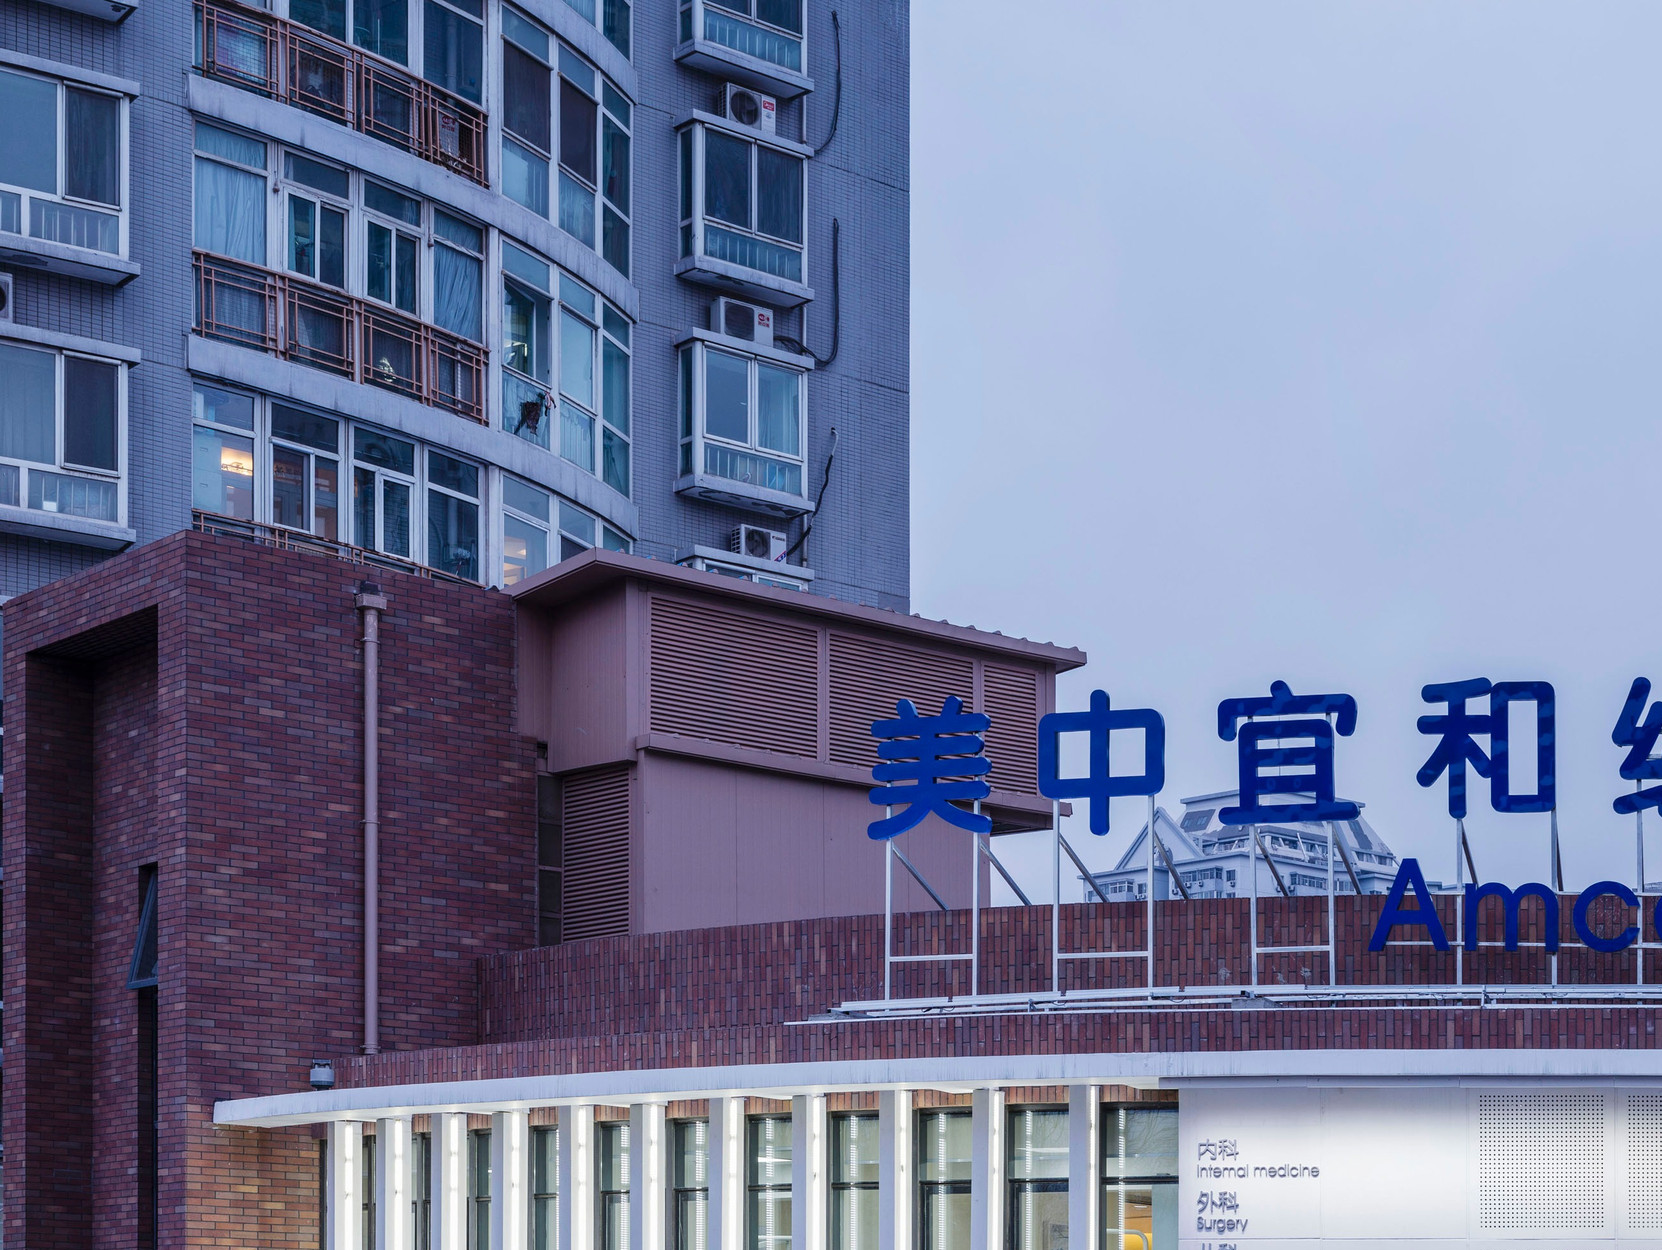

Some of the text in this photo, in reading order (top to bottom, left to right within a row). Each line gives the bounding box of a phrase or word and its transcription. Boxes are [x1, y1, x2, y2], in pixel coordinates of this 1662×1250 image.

[1197, 1138, 1240, 1161] 内科
[1196, 1164, 1320, 1179] Internal medicine
[1196, 1190, 1240, 1214] 外科
[1196, 1216, 1249, 1234] Surgery
